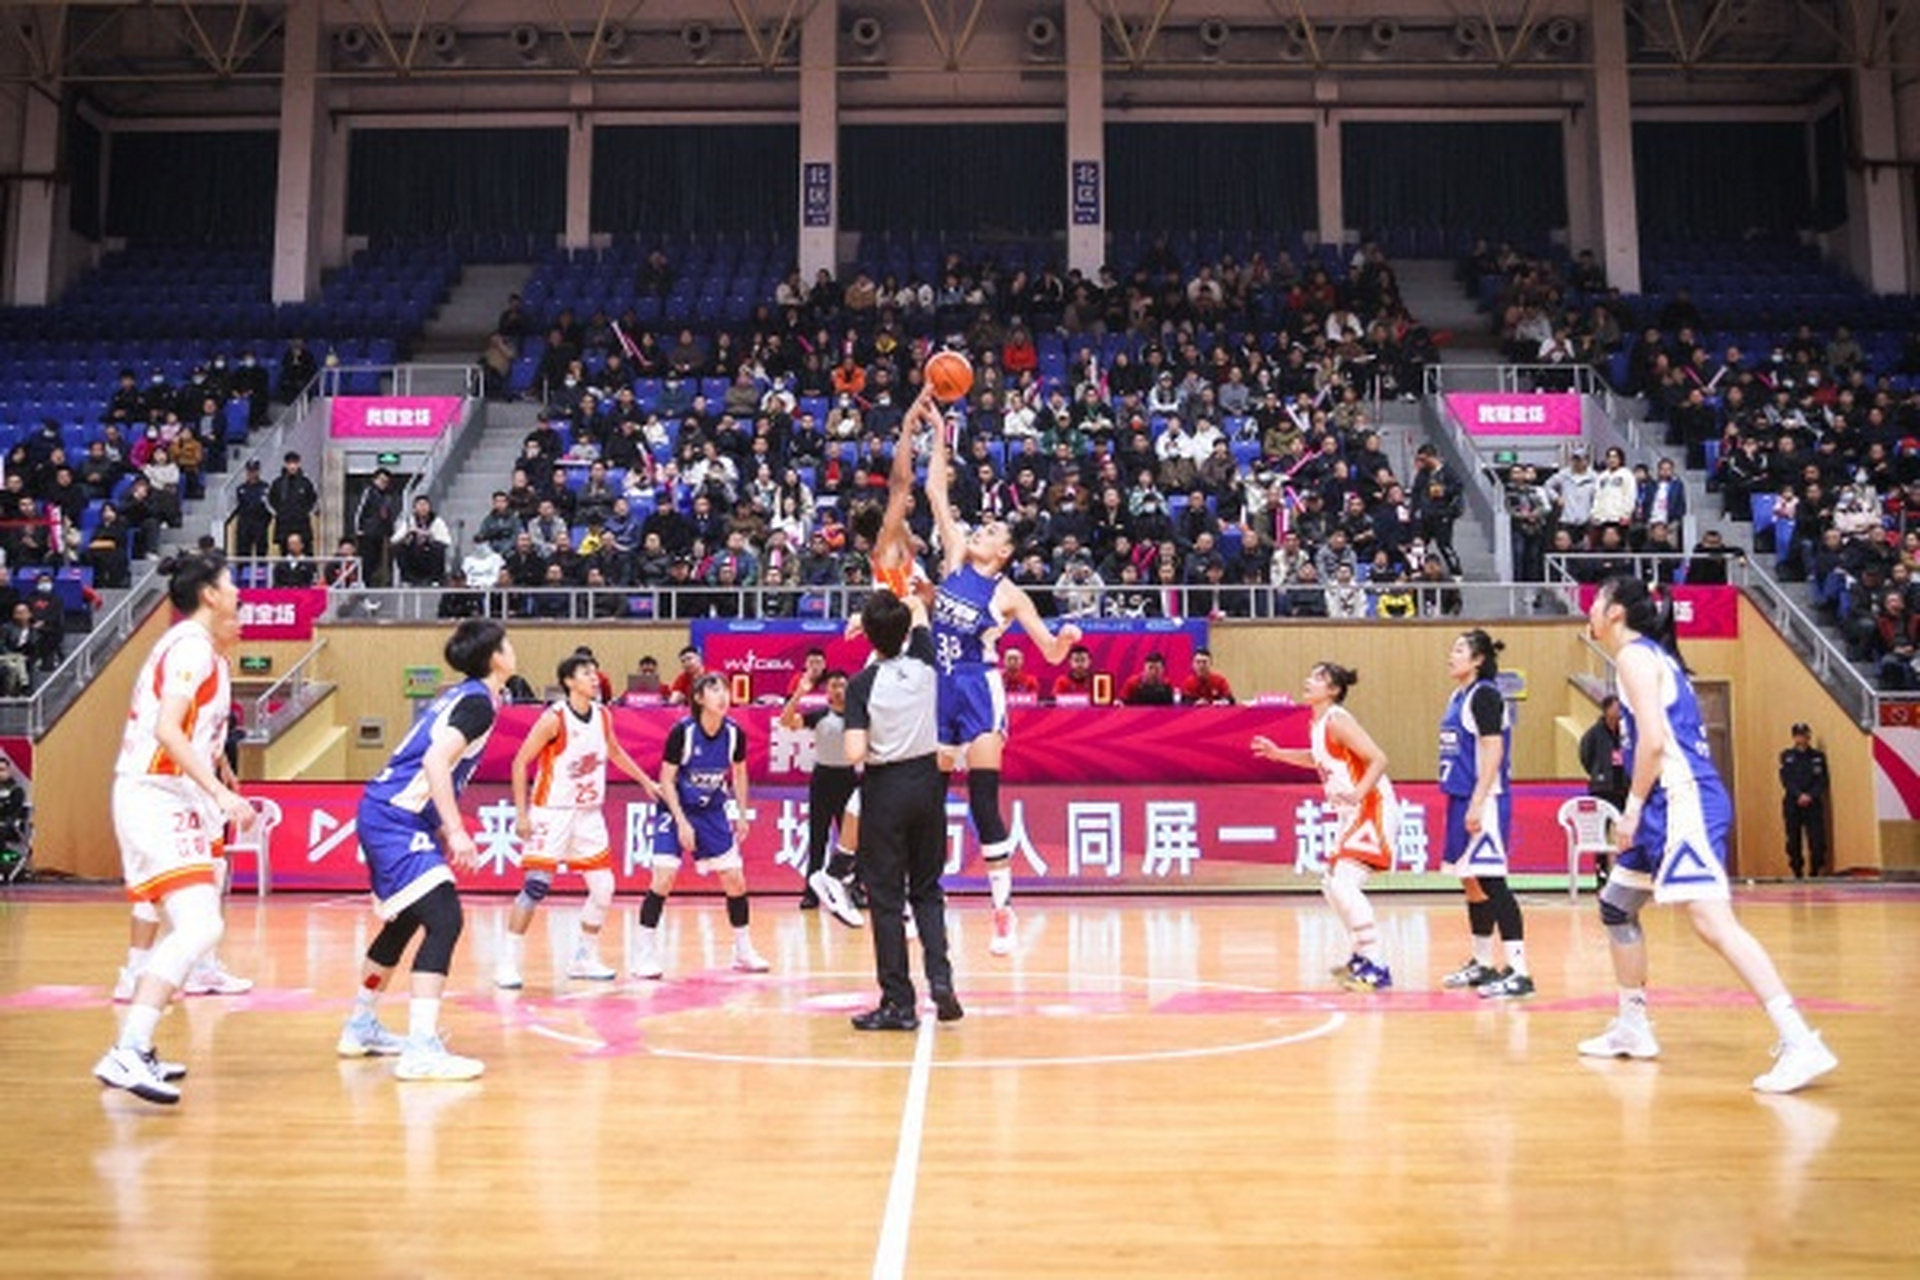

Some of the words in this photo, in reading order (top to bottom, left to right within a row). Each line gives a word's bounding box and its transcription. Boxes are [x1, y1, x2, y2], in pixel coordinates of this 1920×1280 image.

[731, 674, 750, 704] 0
[1093, 674, 1111, 704] 0
[575, 781, 599, 804] 25
